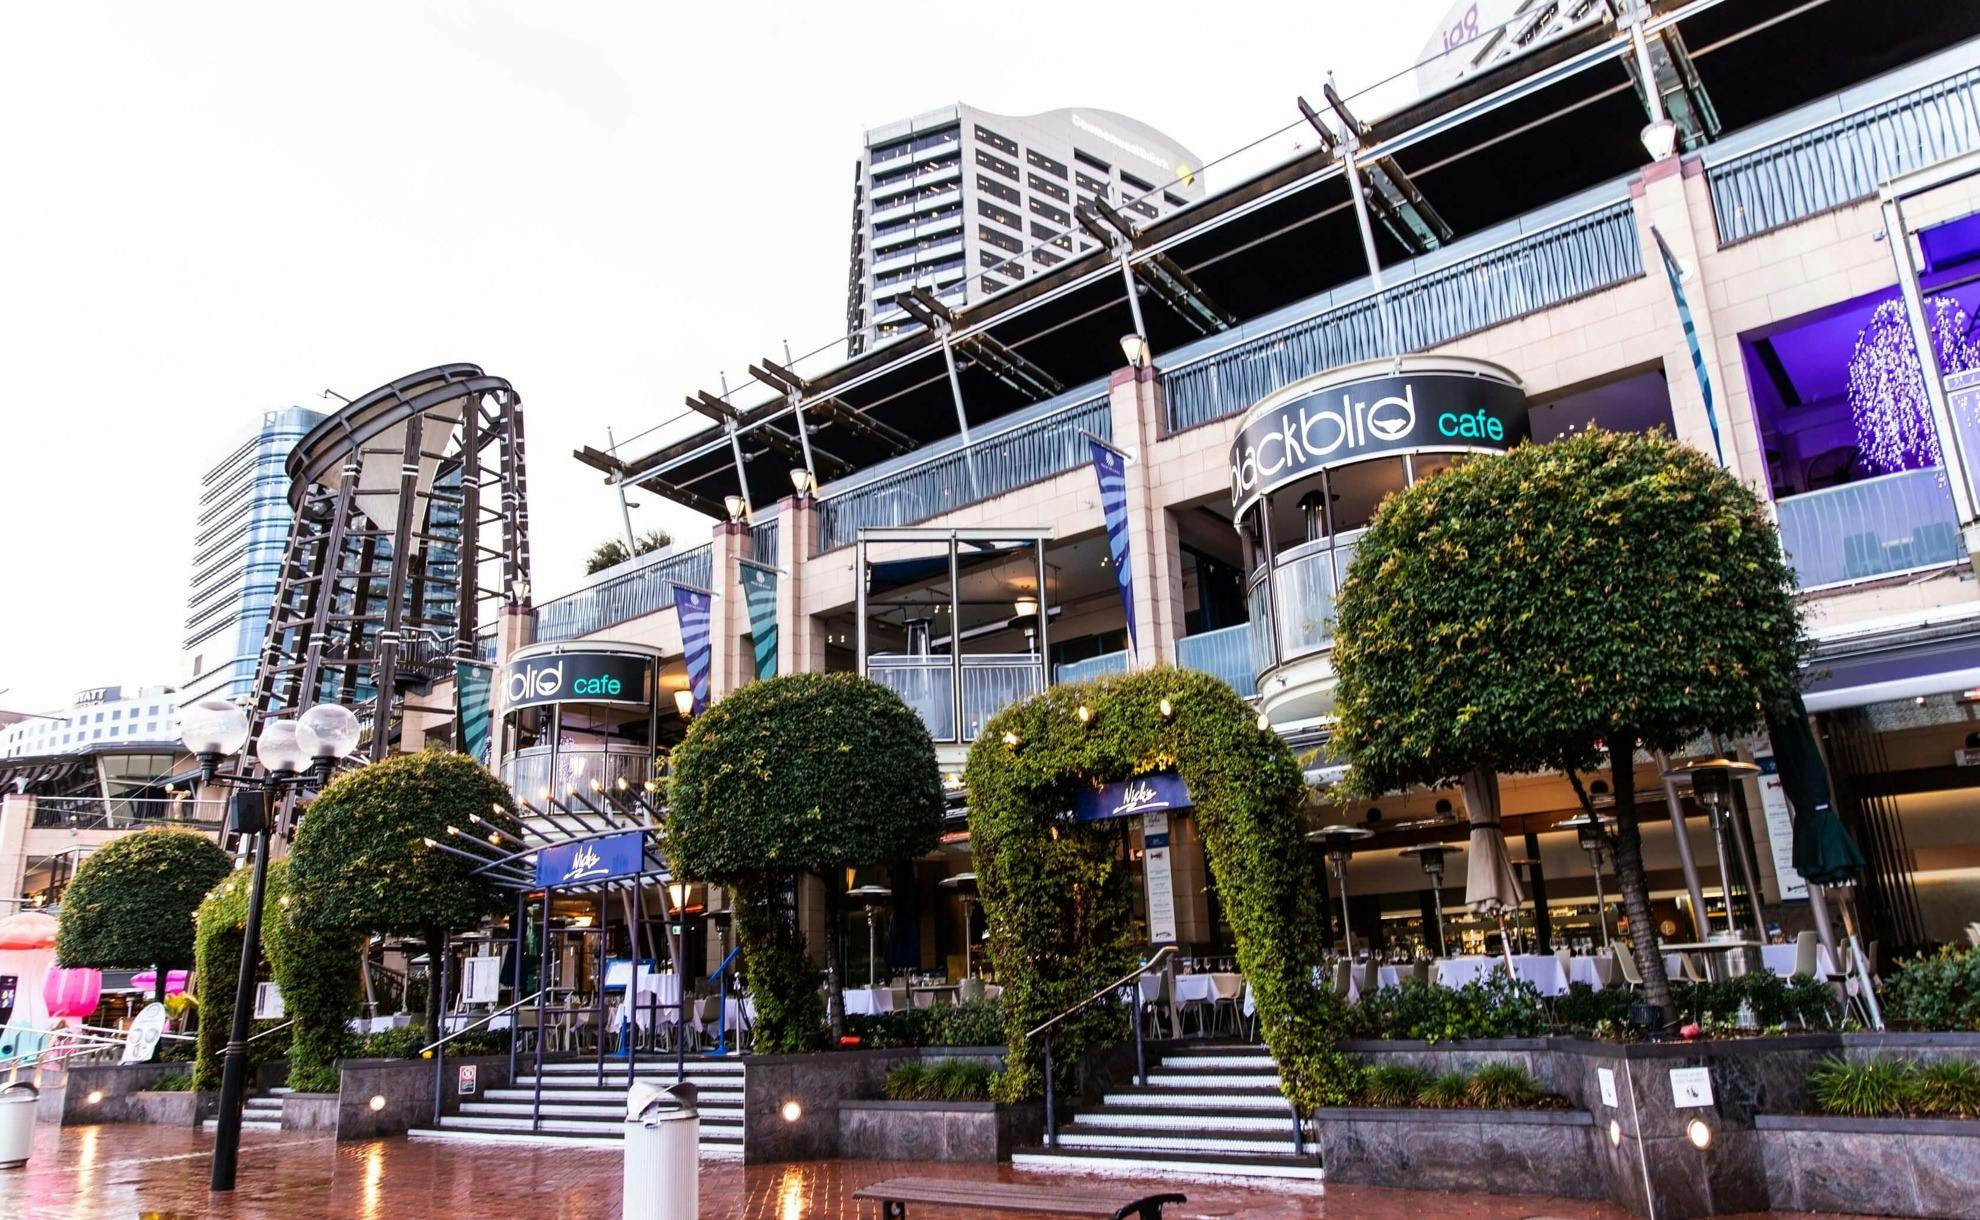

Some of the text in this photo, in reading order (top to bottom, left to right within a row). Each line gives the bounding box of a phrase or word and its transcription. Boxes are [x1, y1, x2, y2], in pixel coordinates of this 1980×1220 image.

[1438, 407, 1504, 442] cafe
[574, 674, 622, 695] cafe
[78, 688, 106, 703] YATT
